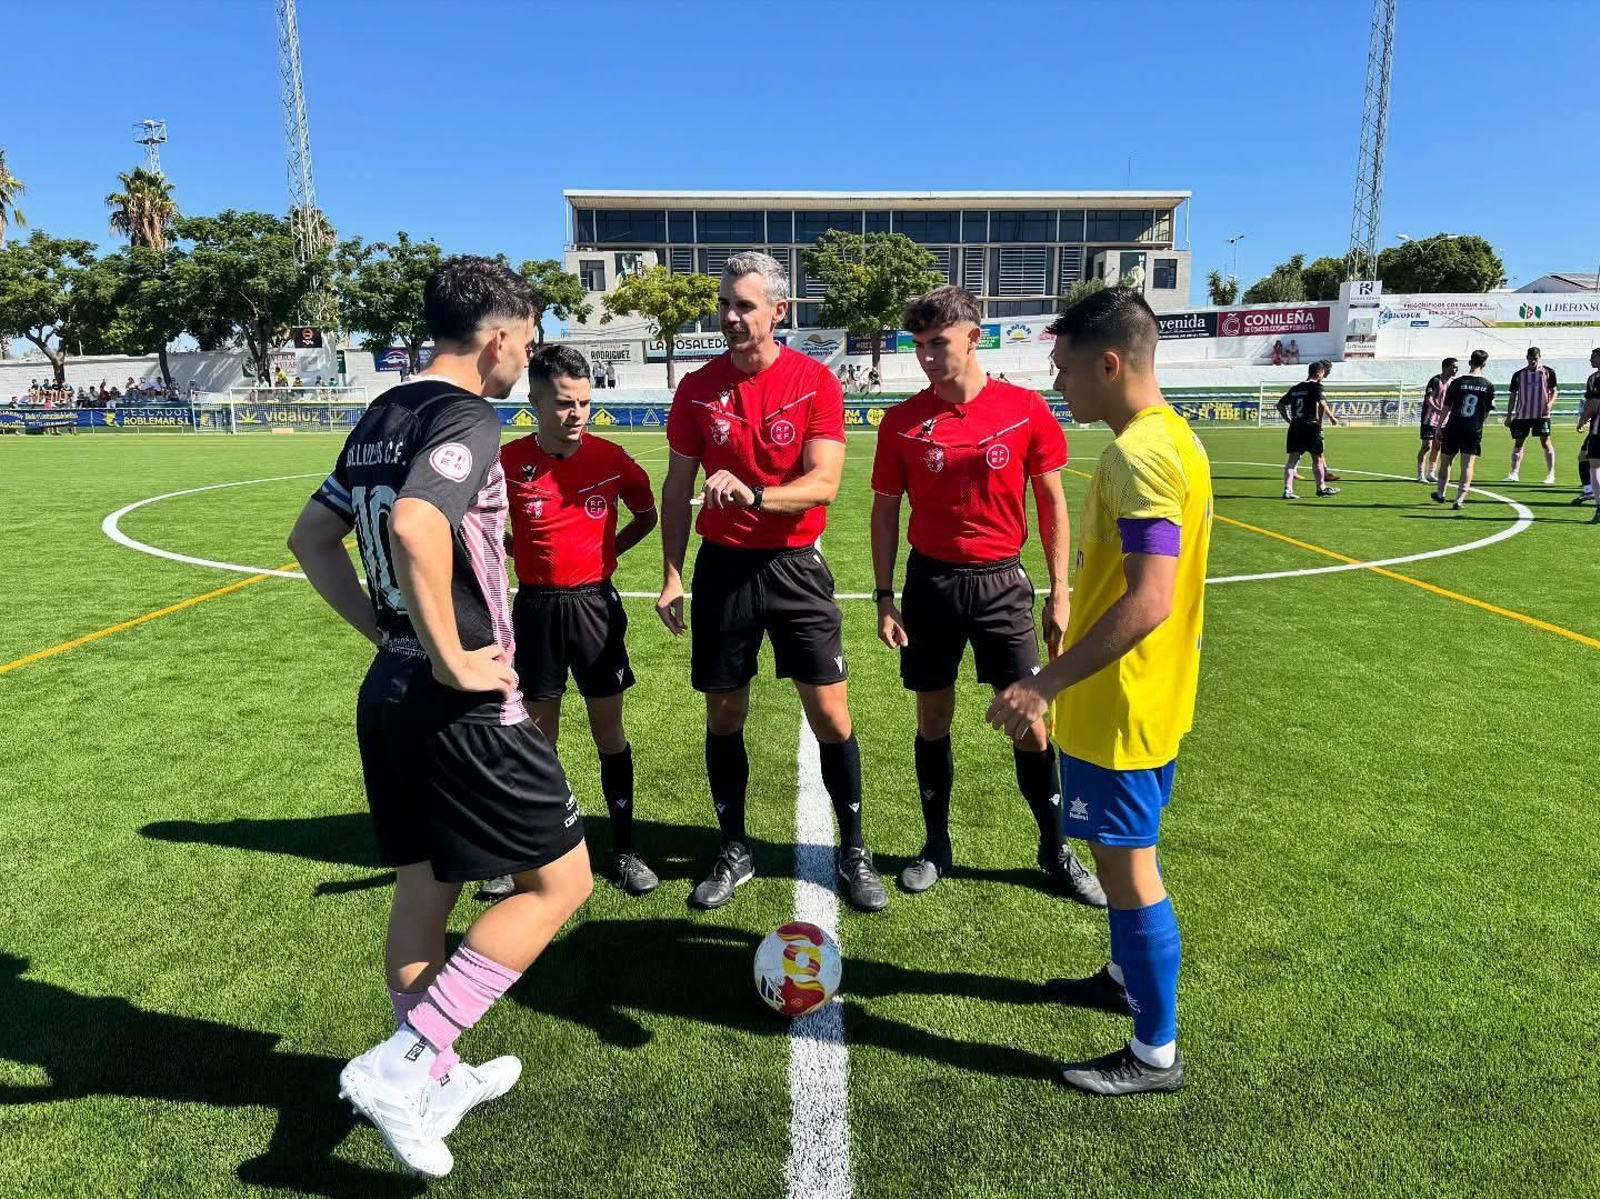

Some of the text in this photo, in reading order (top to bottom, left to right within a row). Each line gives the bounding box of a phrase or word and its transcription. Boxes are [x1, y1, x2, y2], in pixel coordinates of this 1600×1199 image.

[1158, 313, 1206, 330] venida
[1244, 310, 1315, 326] CONILEÑA
[649, 338, 729, 351] LA OSALEDA
[122, 408, 190, 417] PESCADOS
[1462, 394, 1479, 418] 8
[124, 416, 175, 425] ROBLEMAR
[264, 408, 320, 422] vidaluz
